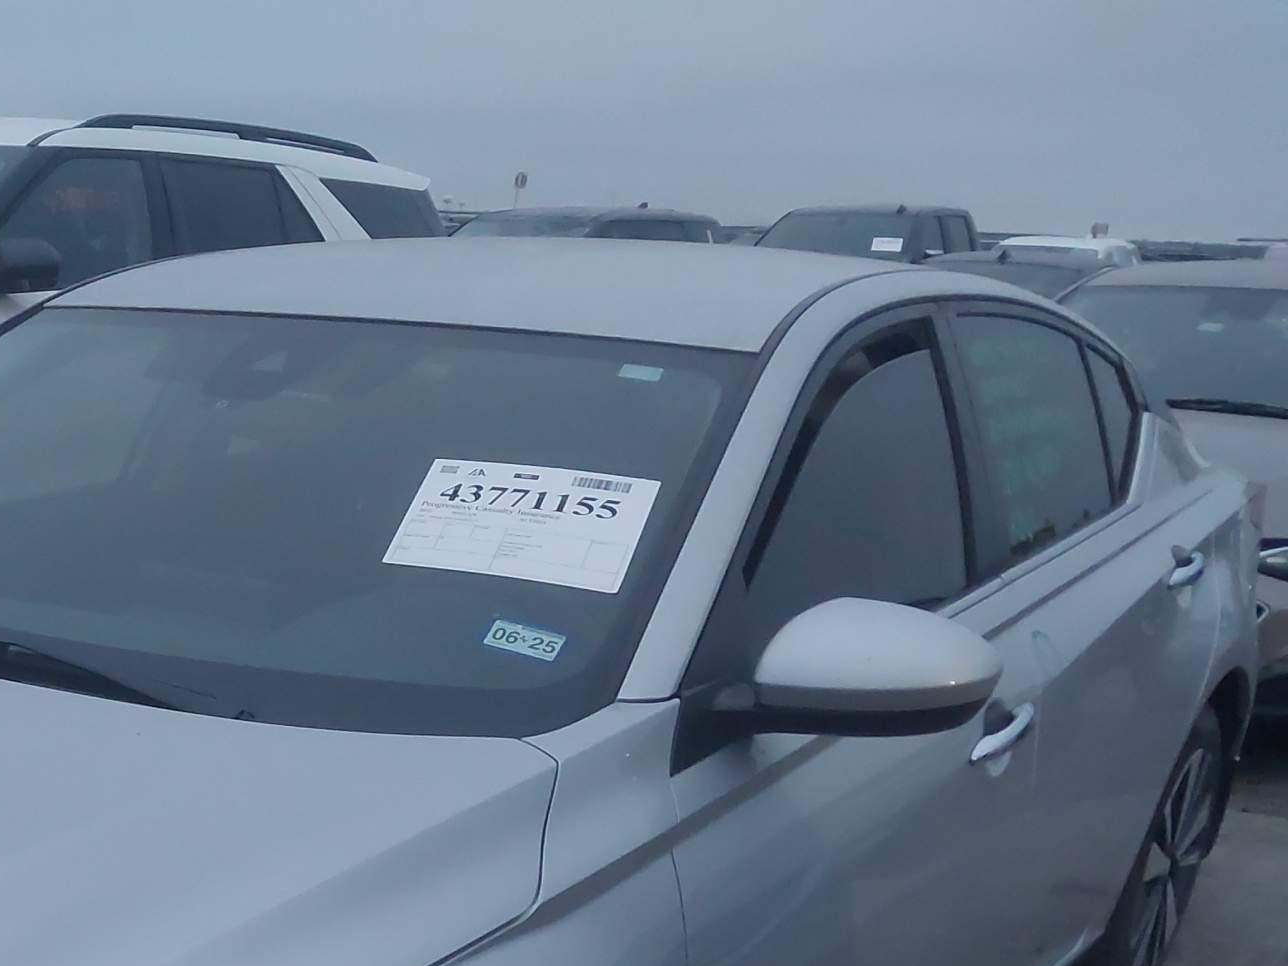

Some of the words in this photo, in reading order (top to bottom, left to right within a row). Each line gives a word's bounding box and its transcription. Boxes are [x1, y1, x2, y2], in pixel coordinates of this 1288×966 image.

[439, 483, 622, 520] 43771155
[492, 627, 521, 644] 06
[527, 637, 559, 654] 25
